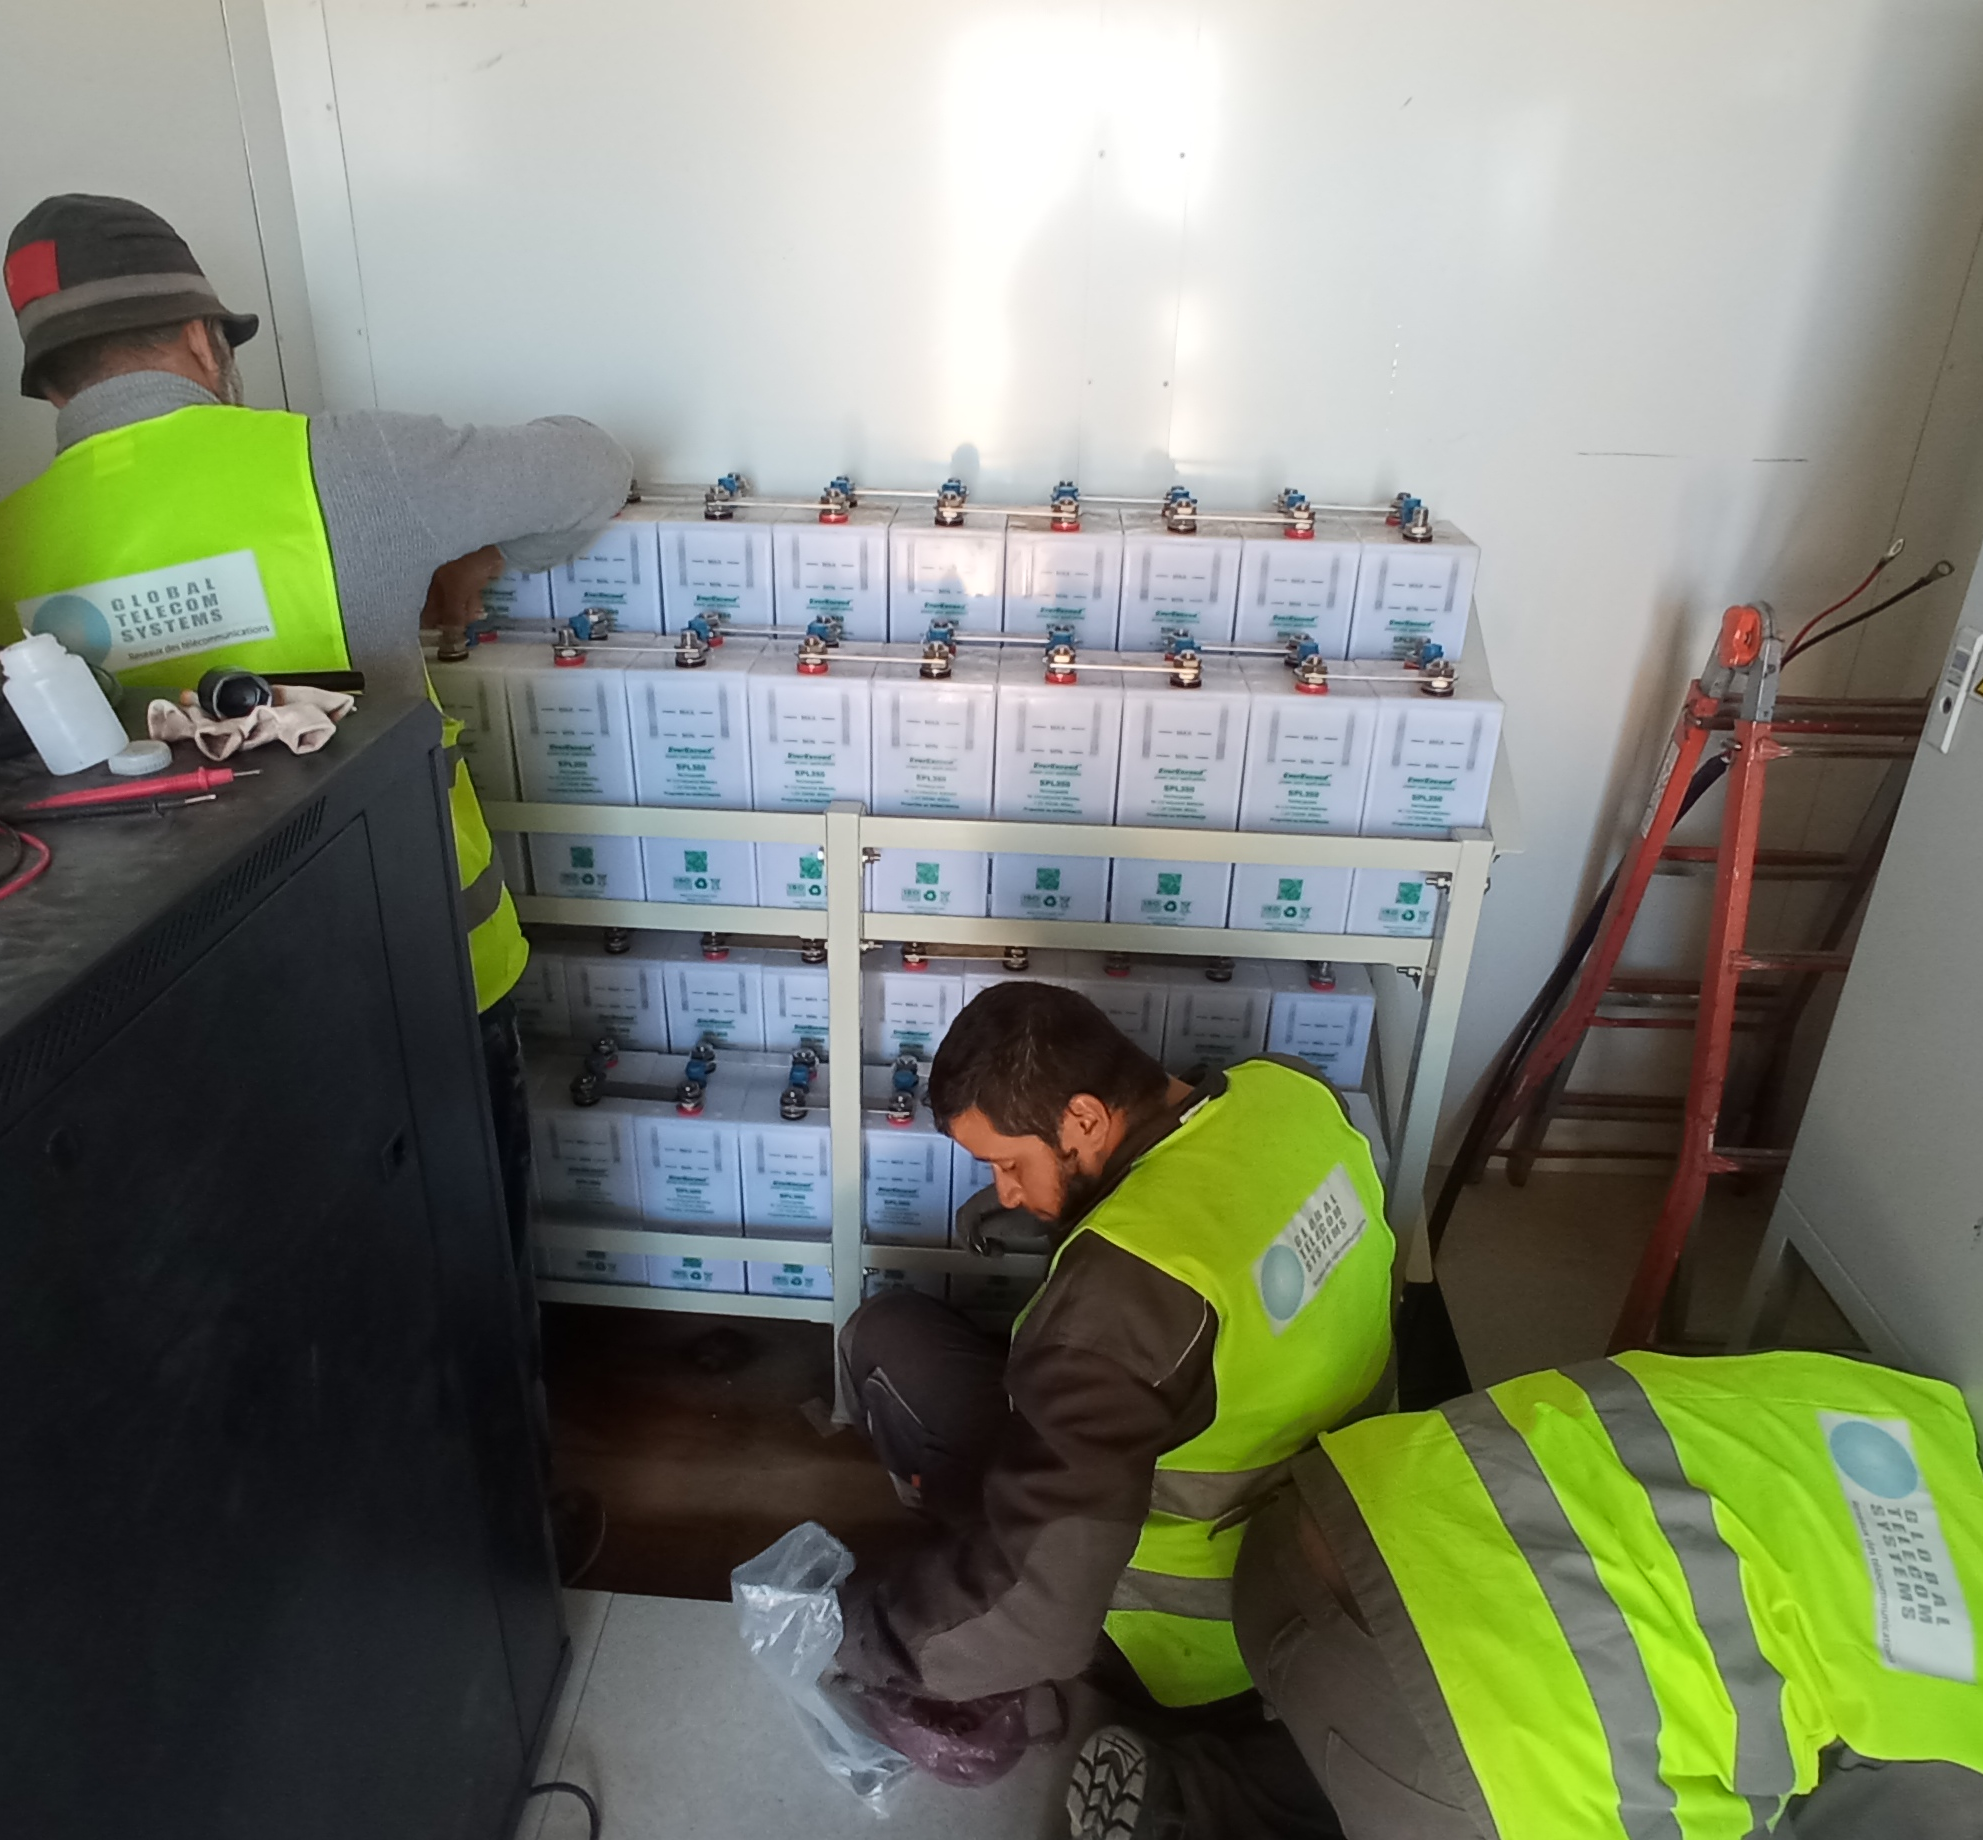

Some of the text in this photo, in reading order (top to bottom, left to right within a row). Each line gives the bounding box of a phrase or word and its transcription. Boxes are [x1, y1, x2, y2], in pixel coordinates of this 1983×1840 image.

[111, 577, 215, 612] GLOBAL
[115, 593, 219, 627] TELECOM
[120, 608, 222, 643] SYSTEMS
[1300, 1205, 1342, 1260] TELECOM
[1305, 1219, 1347, 1272] SYSTEMS
[1870, 1503, 1916, 1620] SYSTEMS
[1888, 1507, 1933, 1624] TELECOM
[1904, 1509, 1950, 1625] GLOBAL
